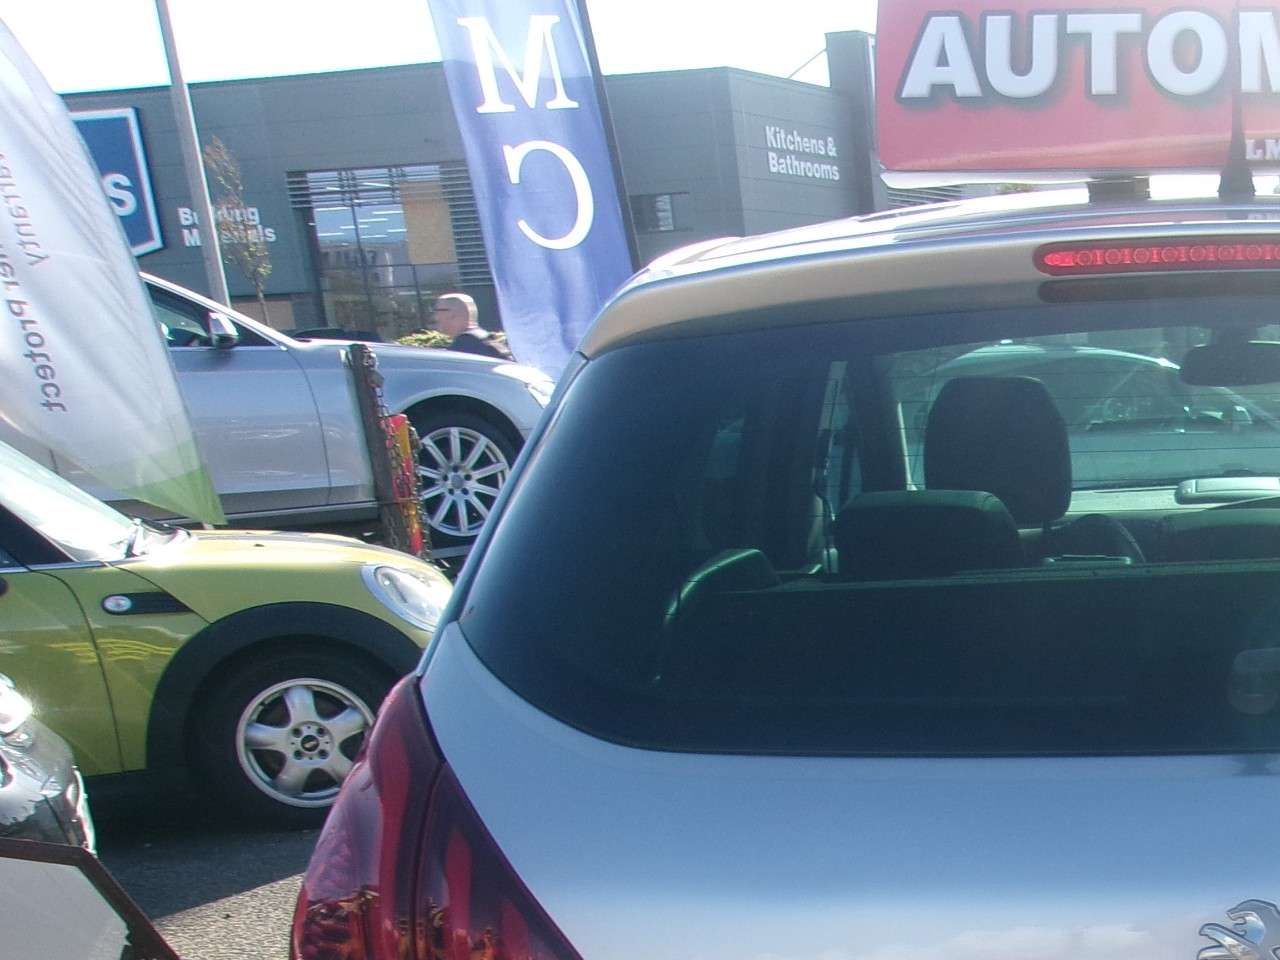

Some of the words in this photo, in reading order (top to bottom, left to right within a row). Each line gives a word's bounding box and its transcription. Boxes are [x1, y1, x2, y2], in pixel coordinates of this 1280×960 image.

[765, 126, 826, 155] Kitchens
[826, 136, 838, 157] &
[767, 151, 840, 181] Bathrooms
